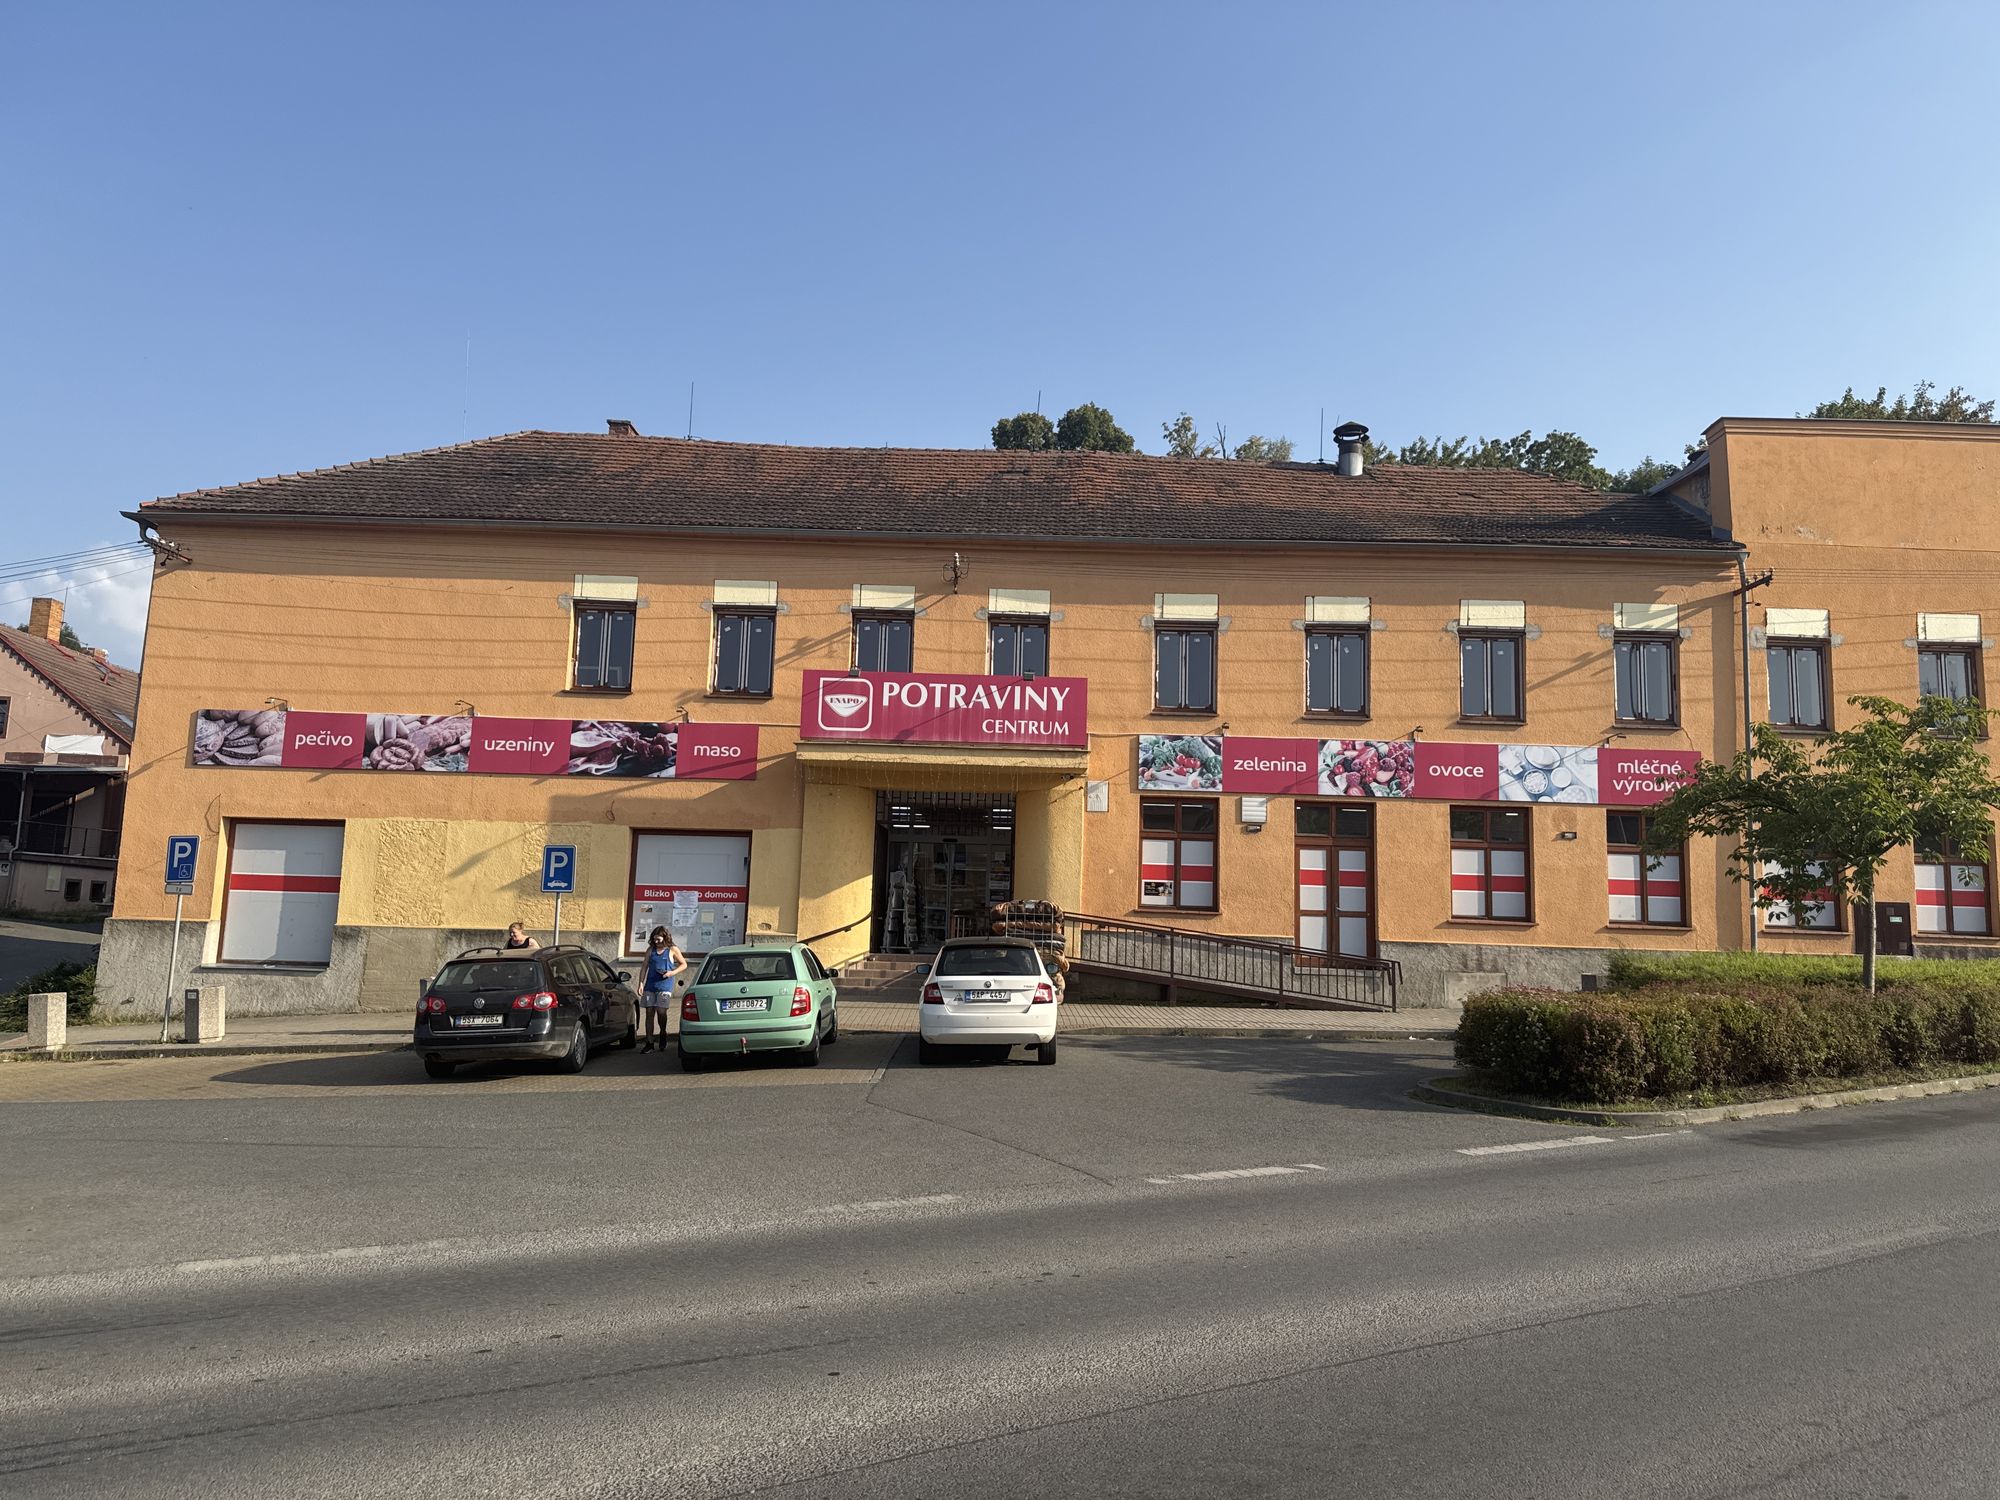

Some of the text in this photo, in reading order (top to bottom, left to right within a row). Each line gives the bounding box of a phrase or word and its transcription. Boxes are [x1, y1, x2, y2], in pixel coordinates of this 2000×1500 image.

[882, 682, 1071, 712] POTRAVINY
[982, 719, 1070, 736] CENTRUM
[294, 730, 353, 750] pečivo
[484, 737, 555, 757] uzeniny
[693, 744, 741, 758] maso
[1233, 756, 1307, 773] zelenina
[1429, 765, 1484, 778] ovoce
[1617, 759, 1682, 775] mléčné
[173, 841, 192, 868] P
[549, 851, 569, 878] P
[704, 890, 738, 899] domova
